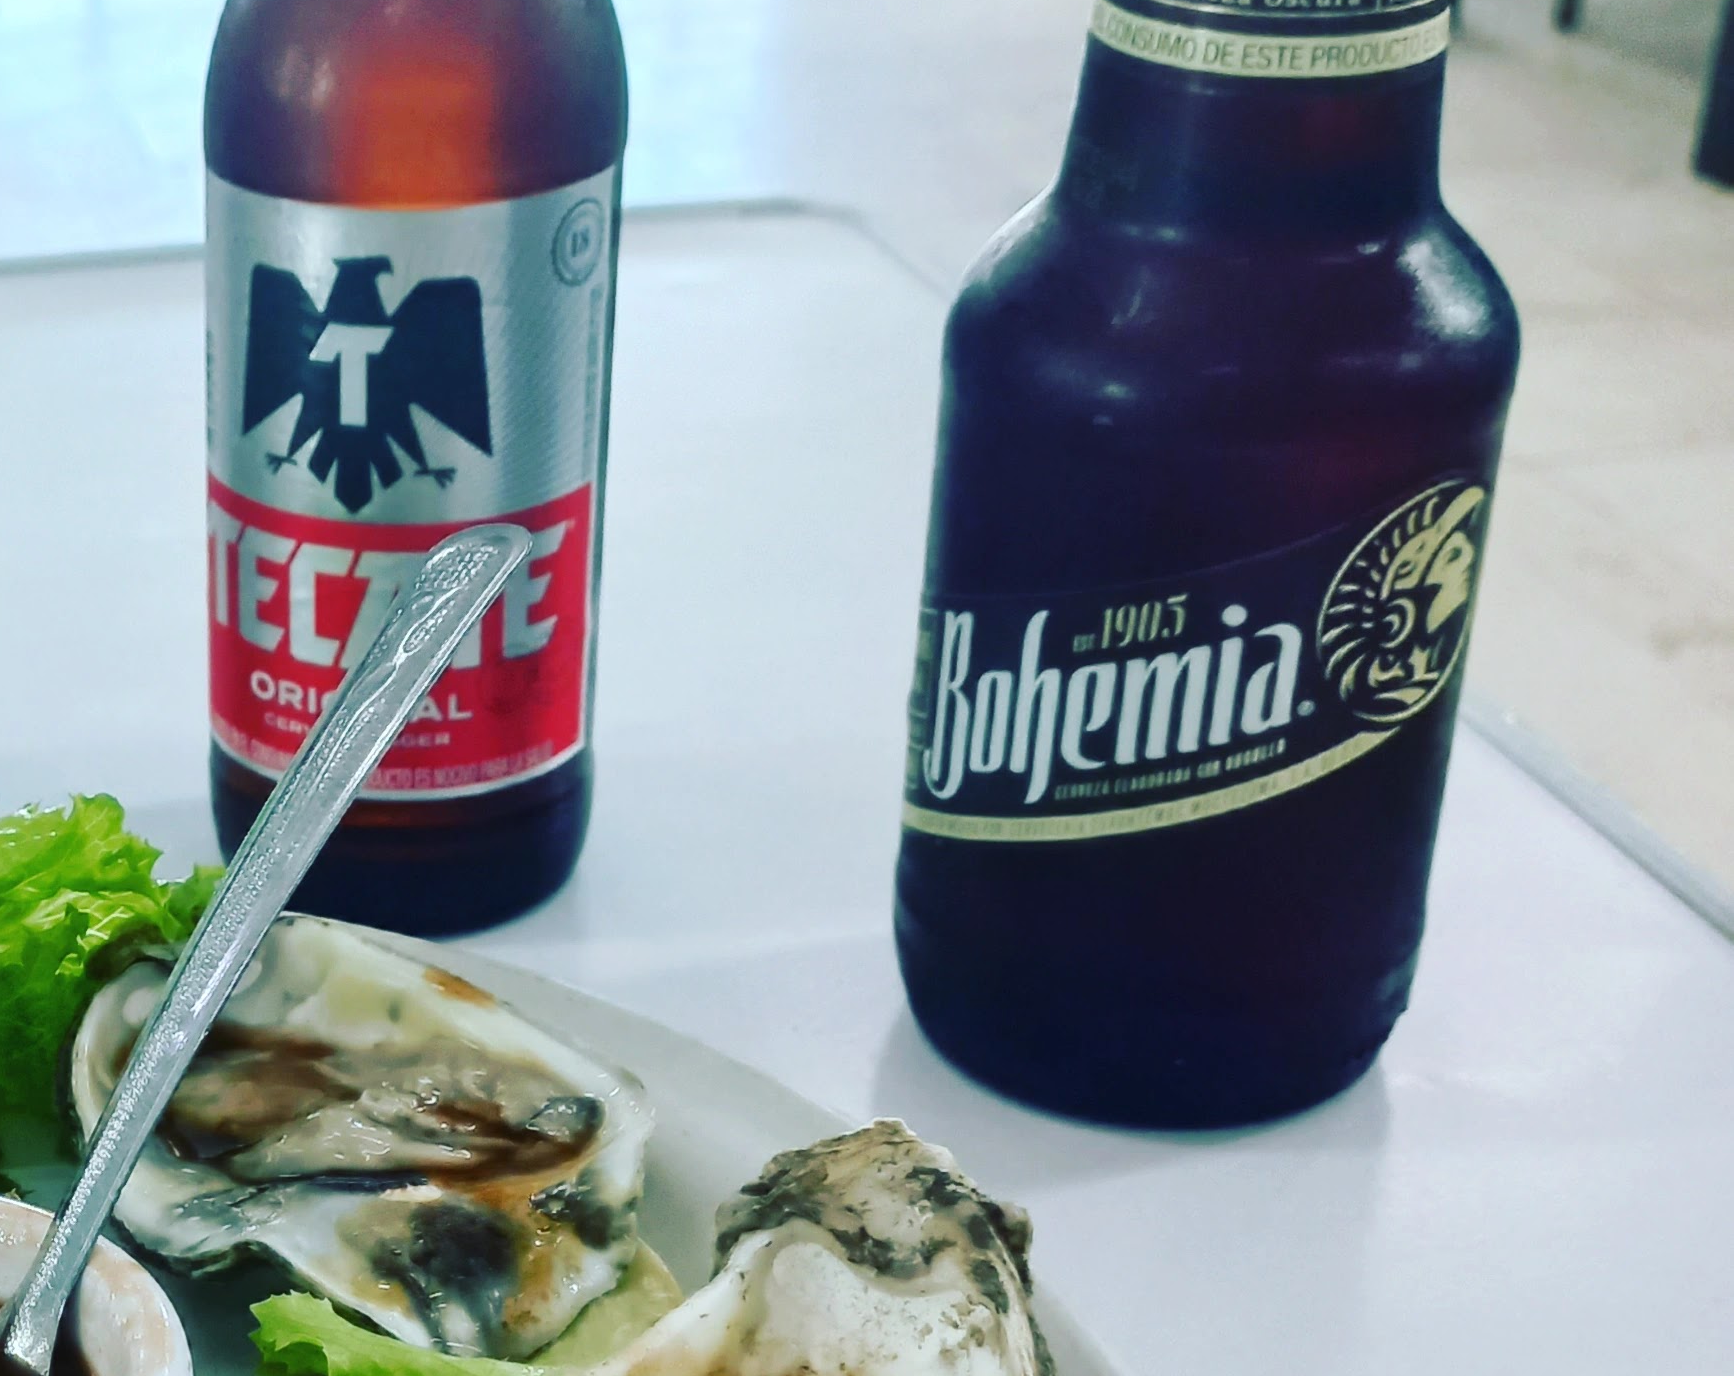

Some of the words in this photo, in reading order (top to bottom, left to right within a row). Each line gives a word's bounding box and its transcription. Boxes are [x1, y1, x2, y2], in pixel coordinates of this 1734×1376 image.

[1202, 36, 1237, 65] DE
[1240, 43, 1304, 70] ESTE
[309, 325, 393, 426] T
[1101, 594, 1187, 649] 1905
[249, 669, 473, 721] ORIAL
[923, 604, 1303, 805] Bohemia
